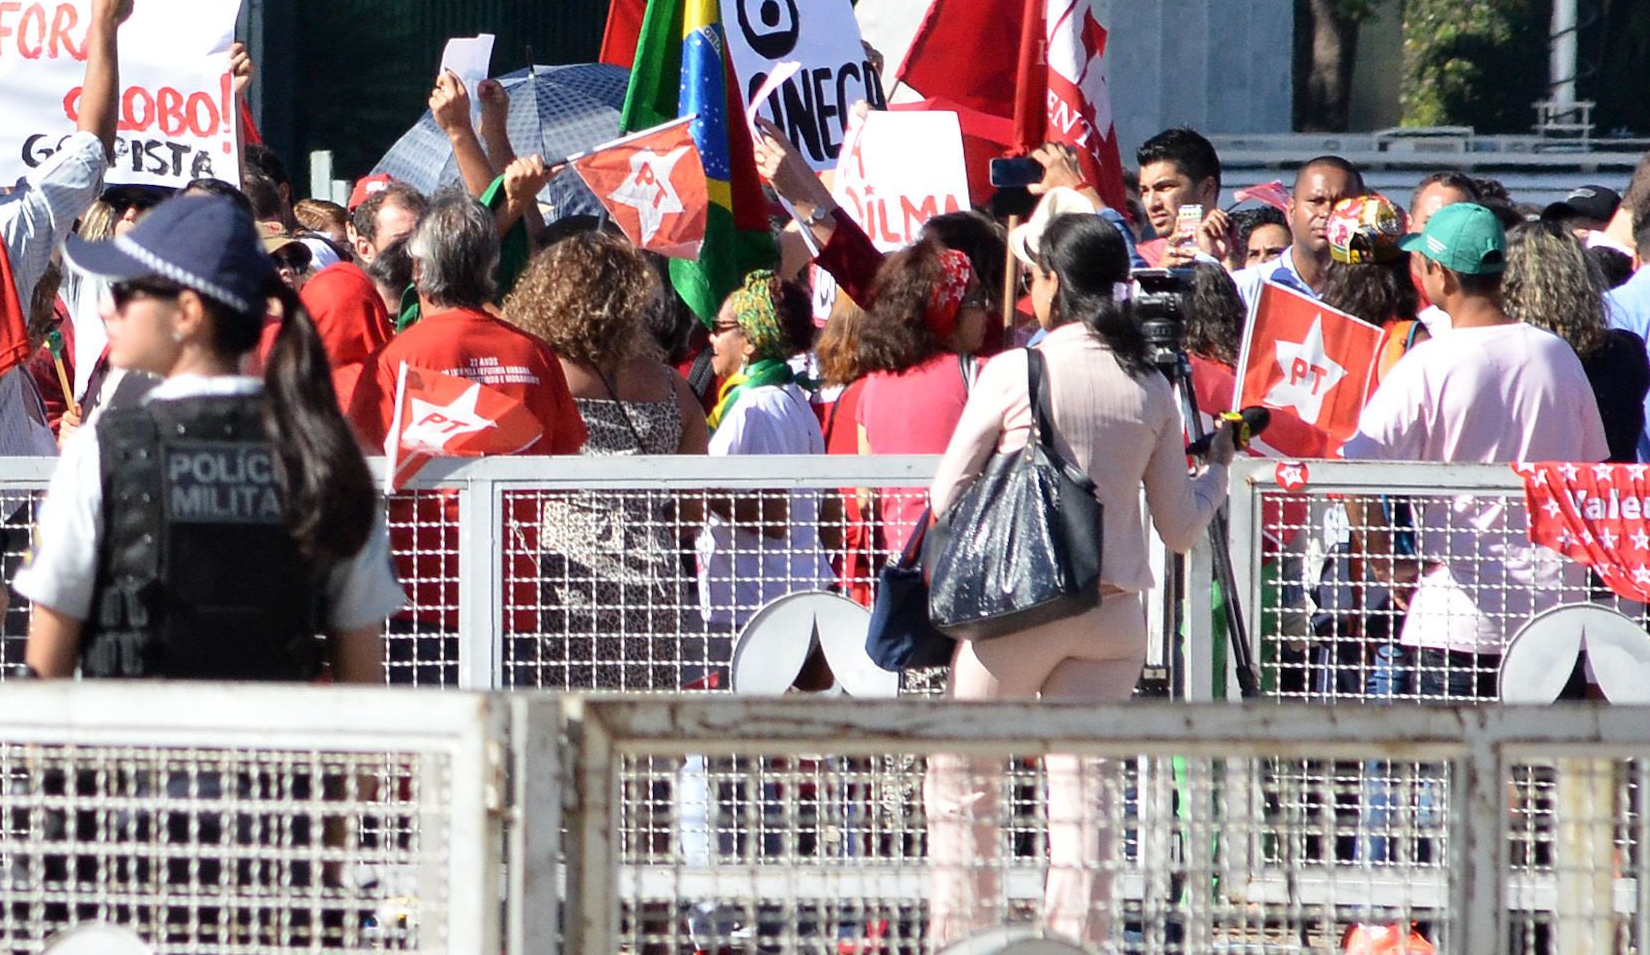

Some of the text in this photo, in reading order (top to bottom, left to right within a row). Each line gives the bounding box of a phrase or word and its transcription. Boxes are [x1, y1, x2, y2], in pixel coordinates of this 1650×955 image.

[63, 72, 231, 155] OBO!
[635, 161, 668, 209] PT
[1290, 357, 1328, 396] PT
[417, 412, 471, 433] PT
[170, 446, 281, 483] POLÍC
[171, 486, 282, 516] MILITA
